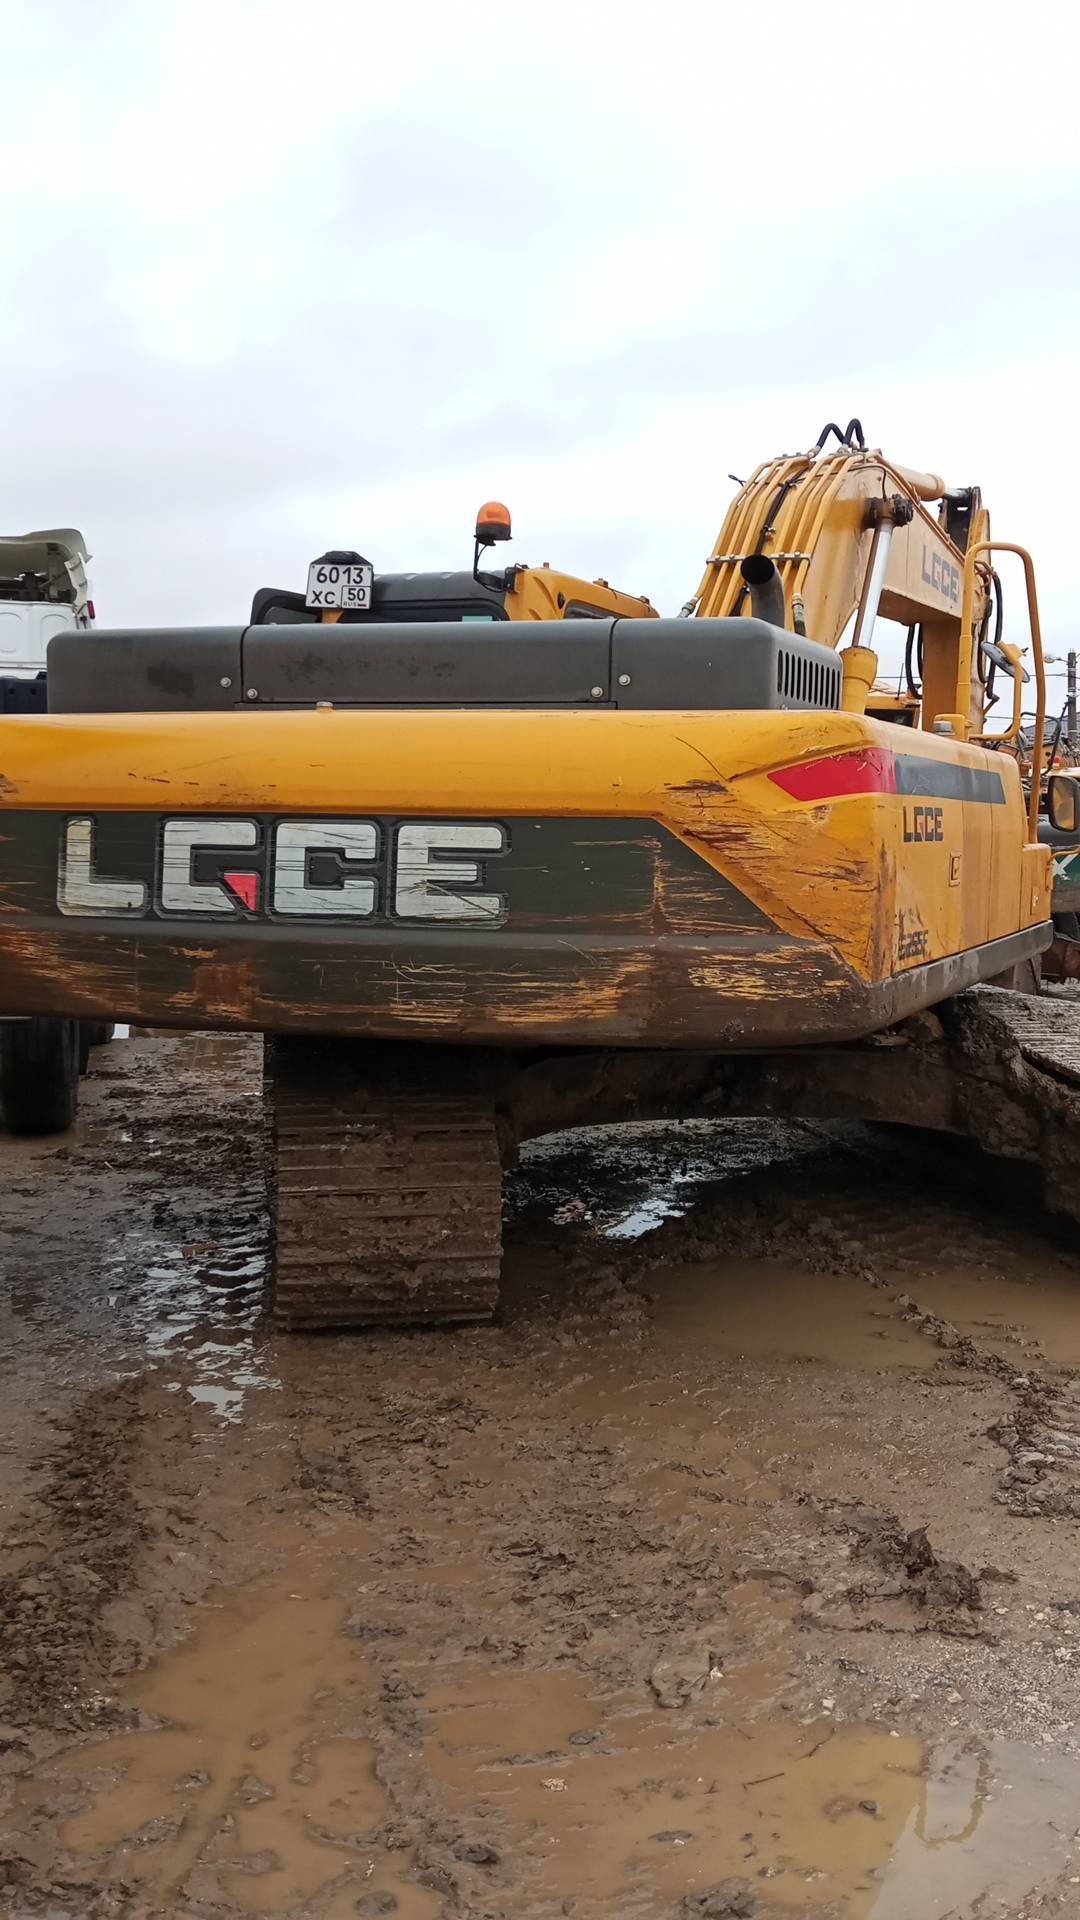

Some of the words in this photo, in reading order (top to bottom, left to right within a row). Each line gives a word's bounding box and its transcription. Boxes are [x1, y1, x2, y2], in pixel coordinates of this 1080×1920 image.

[316, 566, 364, 584] 6013
[921, 544, 960, 602] LGCE
[311, 590, 336, 604] XC
[347, 588, 366, 601] 50
[903, 805, 944, 843] LGCE
[59, 817, 509, 928] LGCE
